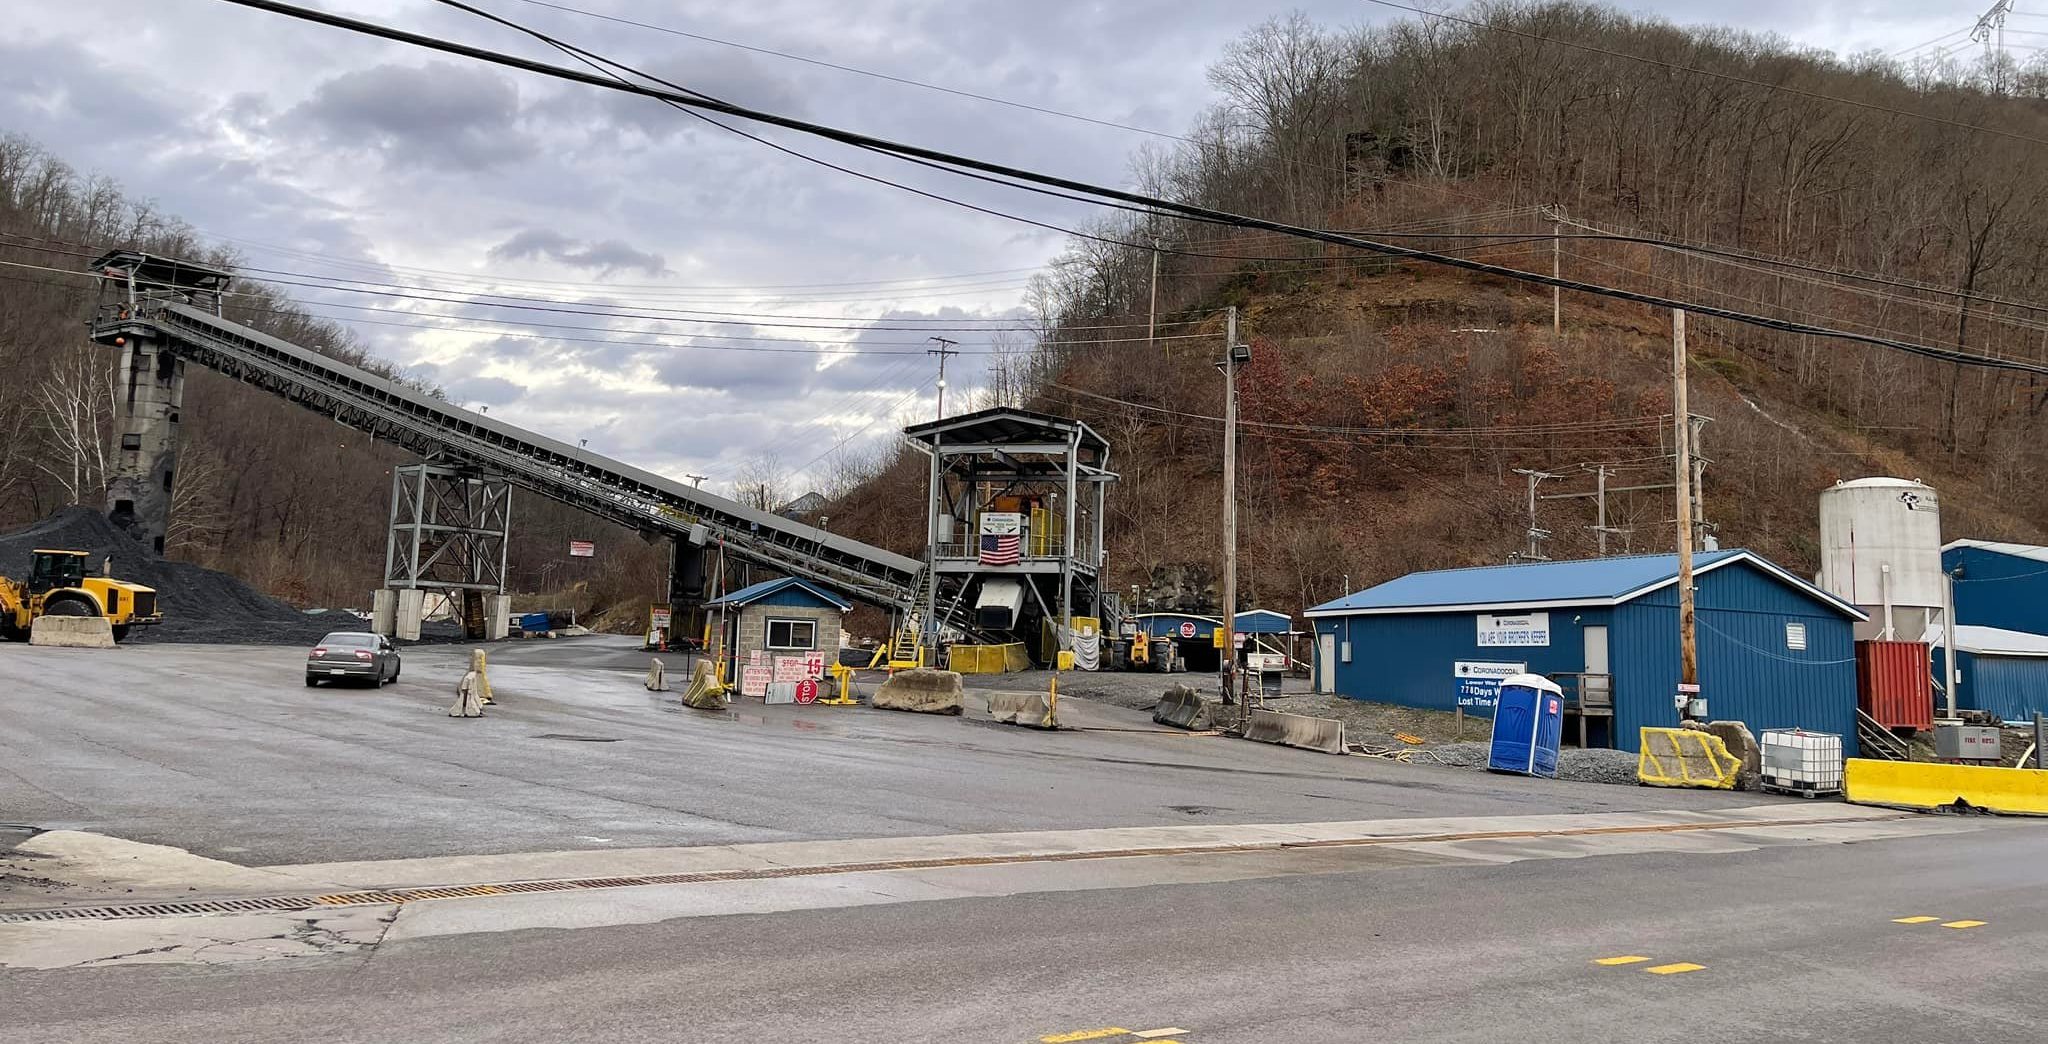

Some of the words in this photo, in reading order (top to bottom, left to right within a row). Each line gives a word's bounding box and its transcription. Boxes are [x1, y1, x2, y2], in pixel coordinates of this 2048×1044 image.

[782, 659, 799, 667] STOP
[807, 658, 821, 675] 15
[801, 680, 811, 702] STOP
[1474, 687, 1492, 697] Days
[1458, 696, 1474, 706] Lost
[1475, 697, 1492, 706] Time
